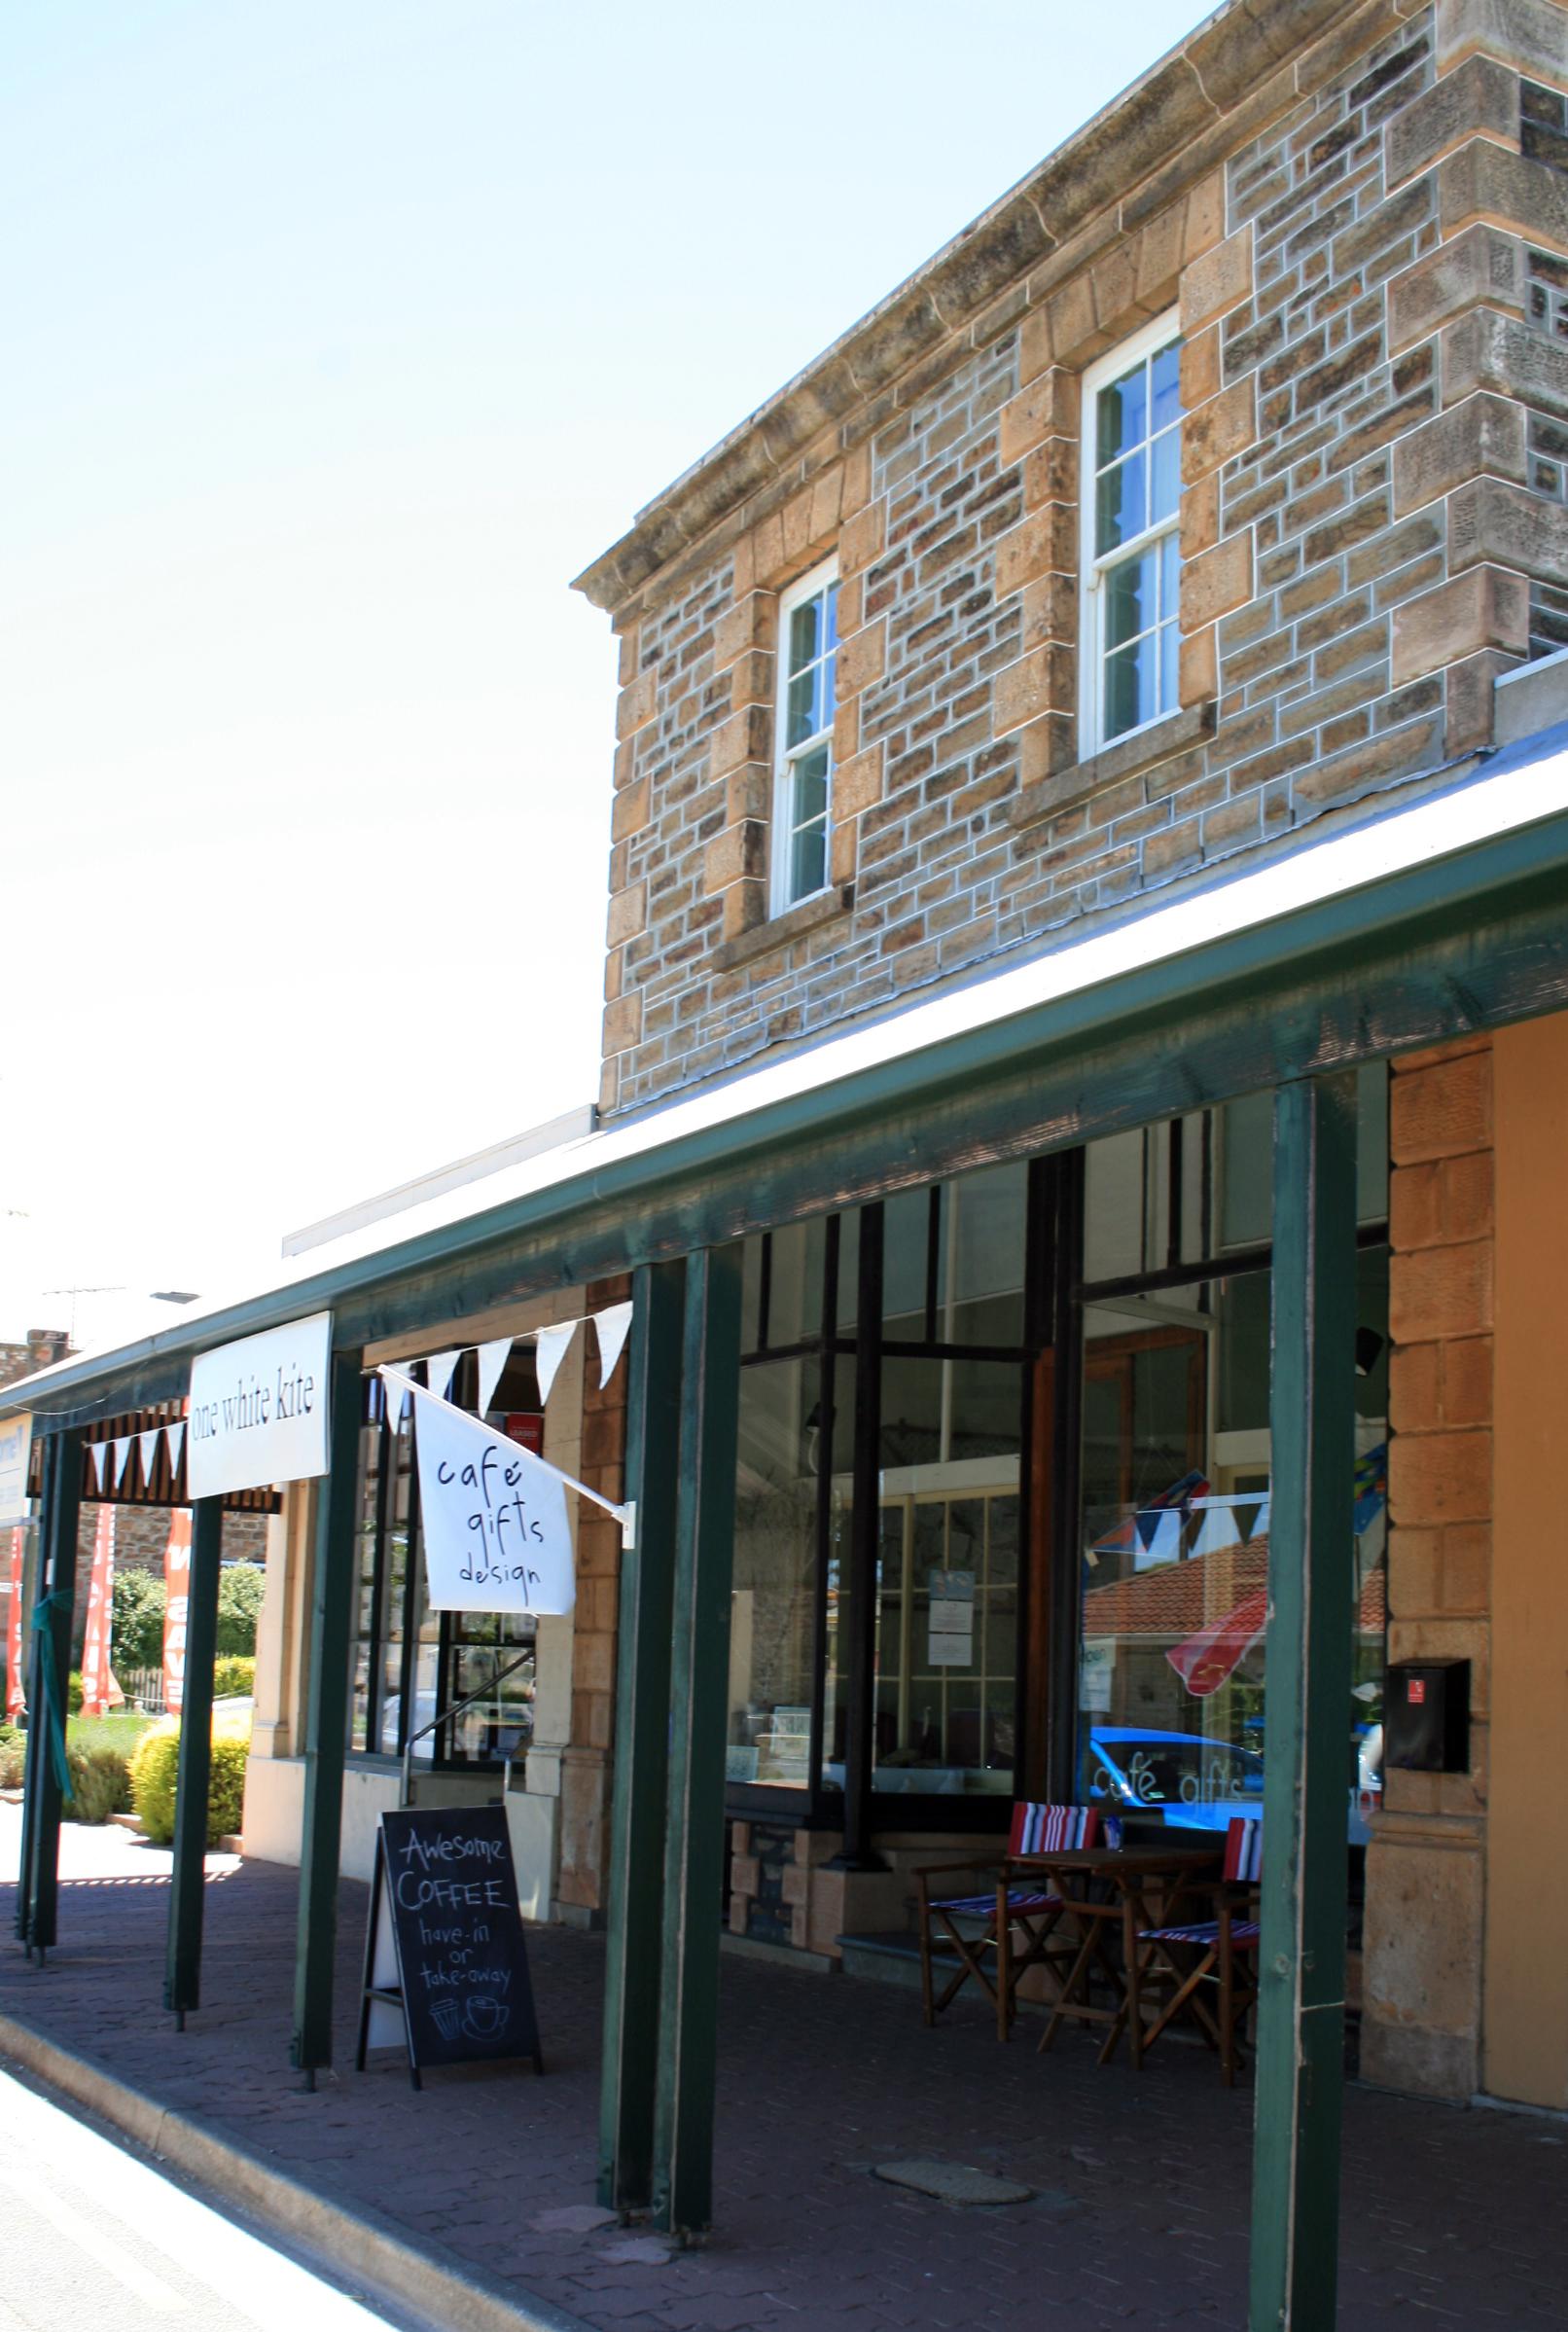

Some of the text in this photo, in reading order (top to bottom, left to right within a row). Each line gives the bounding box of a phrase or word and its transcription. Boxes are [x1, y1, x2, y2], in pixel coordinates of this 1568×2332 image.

[192, 1362, 315, 1442] one white kite
[438, 1445, 523, 1509] café
[467, 1490, 545, 1569] gifts
[459, 1552, 541, 1607] design
[1093, 1750, 1243, 1812] café gifts
[397, 1870, 511, 1911] COFFEE
[419, 1917, 490, 1946] have-in
[448, 1948, 474, 1965] or
[419, 1961, 512, 1994] take-away
